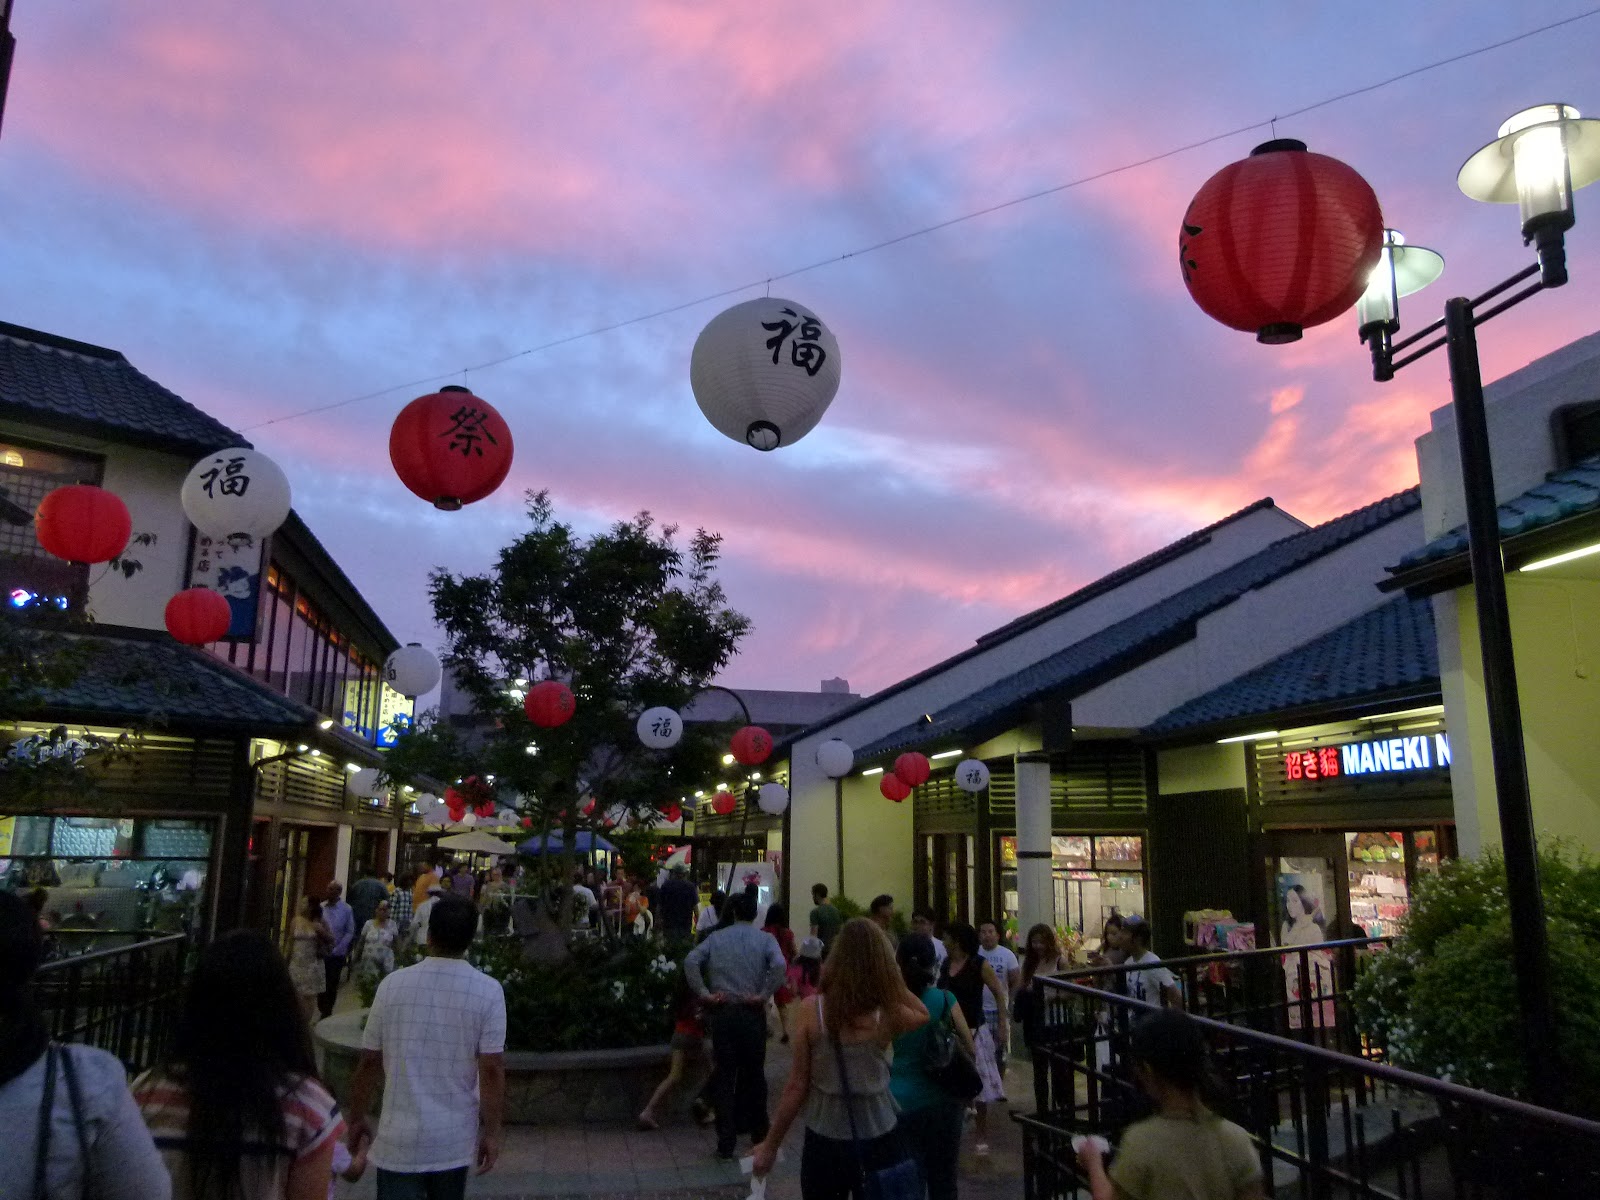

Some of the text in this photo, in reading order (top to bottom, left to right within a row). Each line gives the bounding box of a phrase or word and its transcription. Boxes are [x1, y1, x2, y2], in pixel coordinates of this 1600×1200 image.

[763, 307, 827, 377] 福
[441, 405, 498, 456] 祭
[200, 457, 249, 499] 福
[651, 717, 672, 738] 福
[1342, 735, 1429, 775] MANEKI
[965, 769, 983, 785] 福
